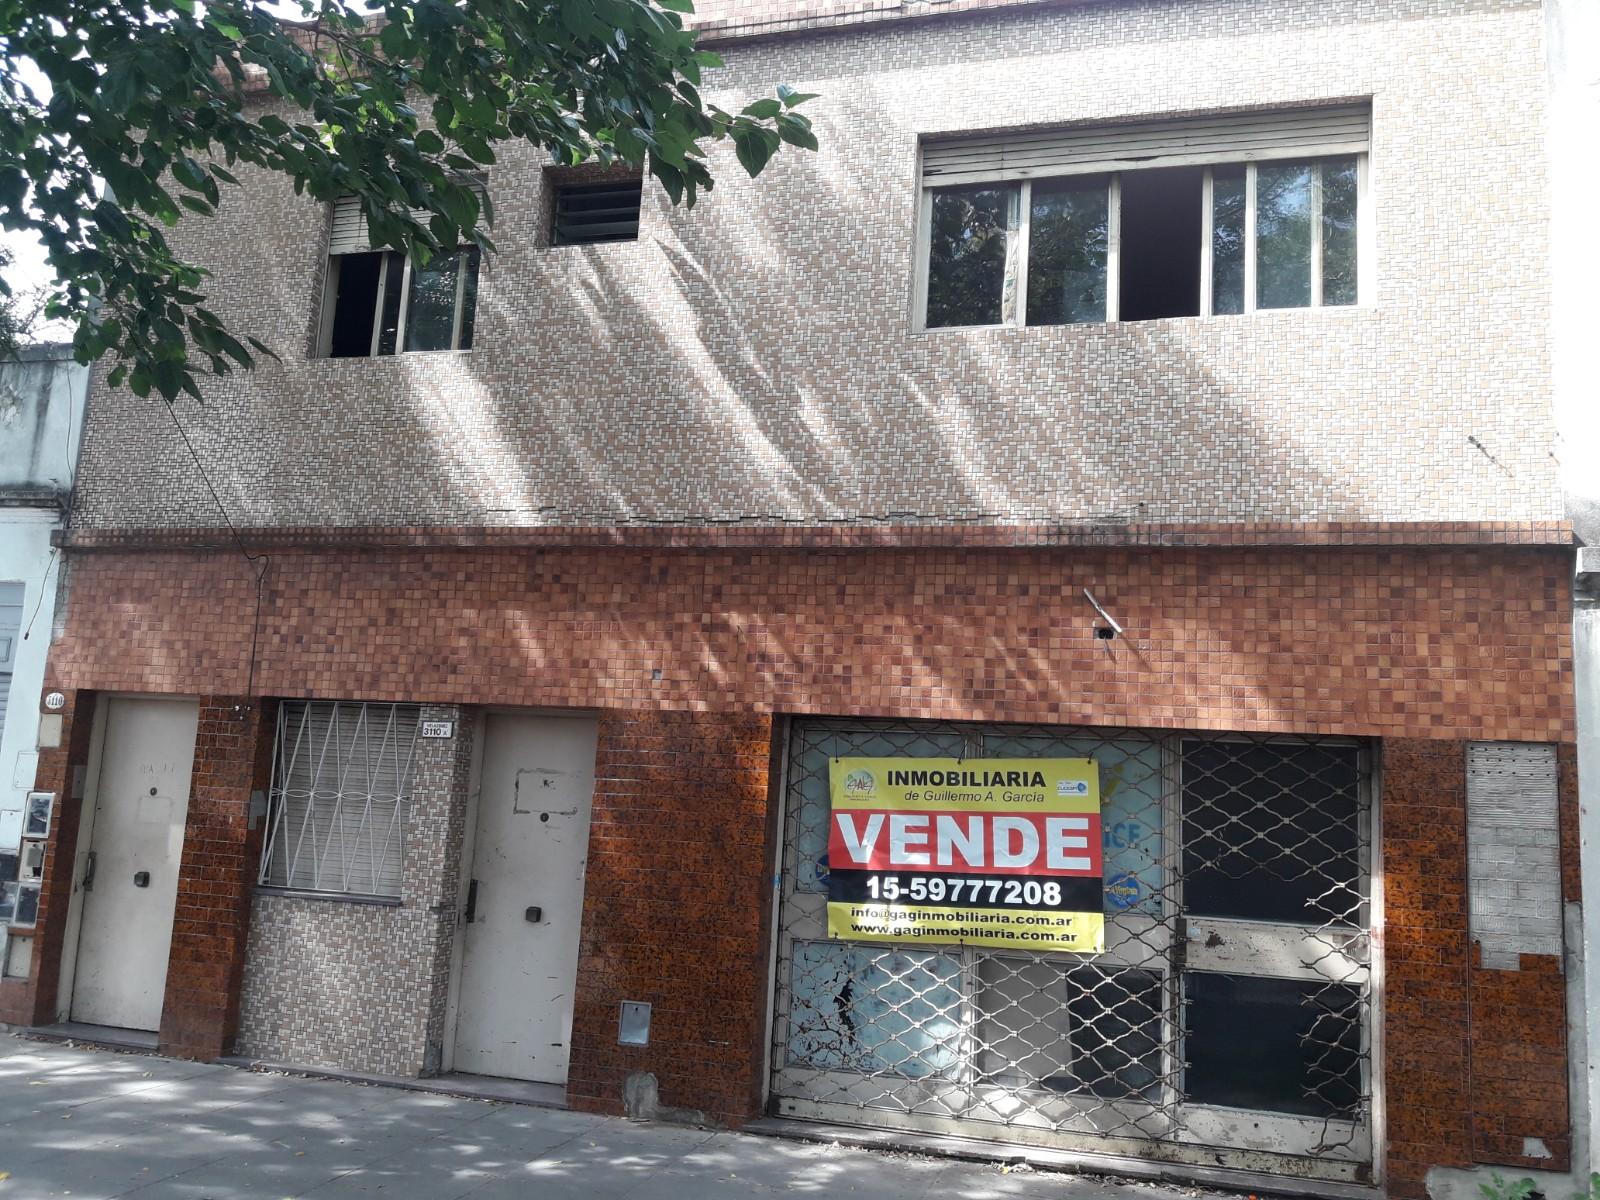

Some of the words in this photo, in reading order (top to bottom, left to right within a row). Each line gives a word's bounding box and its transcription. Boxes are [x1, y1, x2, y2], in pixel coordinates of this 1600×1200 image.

[423, 728, 442, 736] 3110
[887, 770, 1047, 788] INMOBILIARIA
[904, 790, 919, 801] de
[923, 790, 982, 802] Guillermo
[984, 791, 997, 802] A.
[836, 813, 1092, 870] VENDE
[866, 875, 1062, 906] 15-59777208
[851, 907, 1073, 927] info@gaginmobiliaria.com.ar
[850, 923, 1078, 942] www.gaginmobiliaria.com.ar
